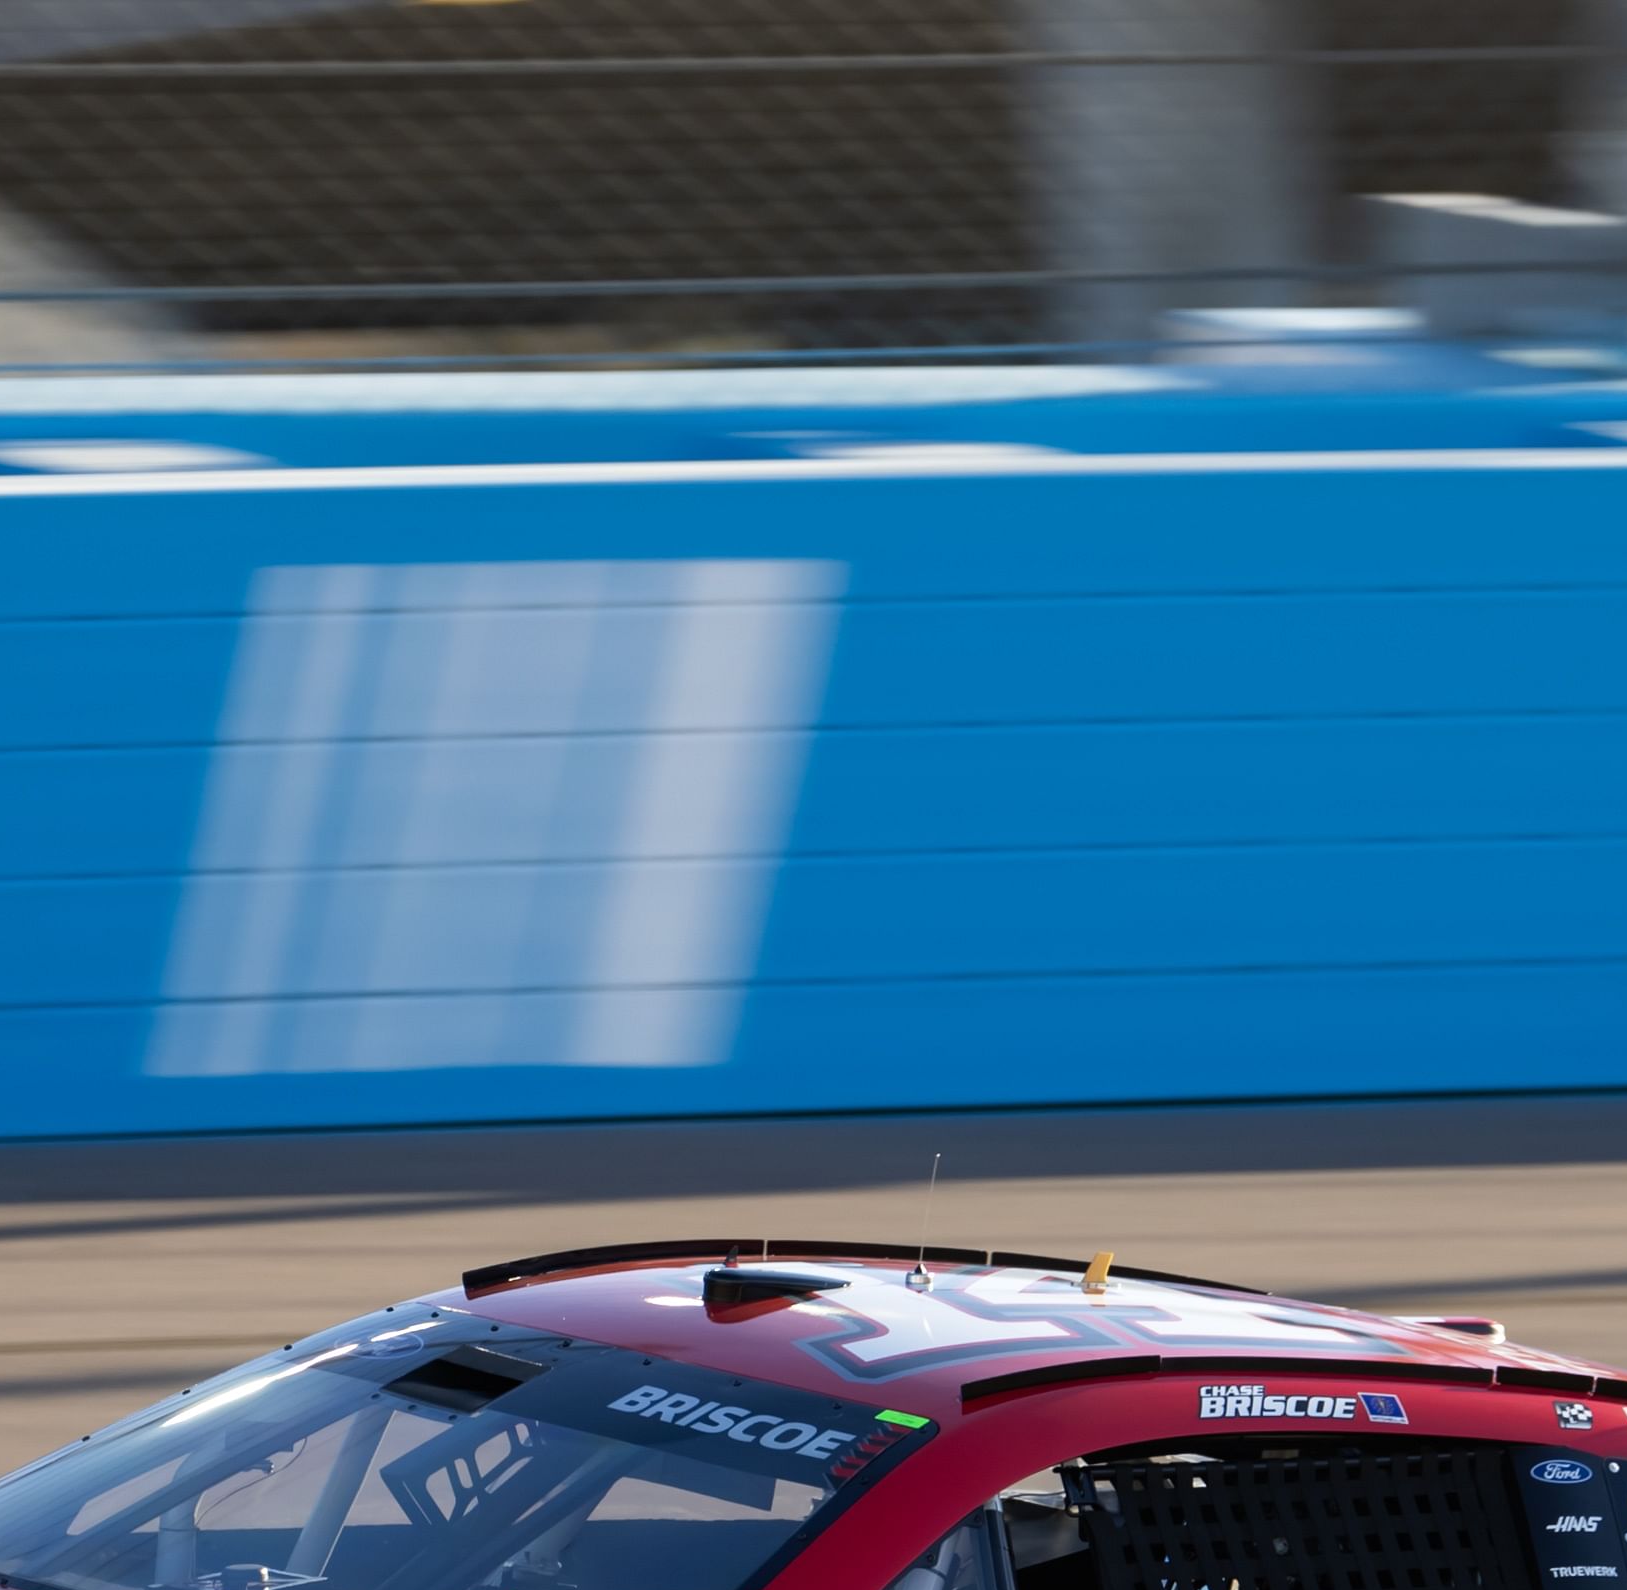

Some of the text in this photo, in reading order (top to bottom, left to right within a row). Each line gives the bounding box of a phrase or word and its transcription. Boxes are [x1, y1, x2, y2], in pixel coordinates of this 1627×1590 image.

[1200, 1385, 1264, 1397] CHASE
[1200, 1396, 1357, 1419] BRISCOE
[607, 1384, 857, 1461] BRISCOE
[1543, 1462, 1581, 1480] Ford
[1545, 1515, 1603, 1533] HAAS
[1550, 1565, 1619, 1578] TRUEWERK
